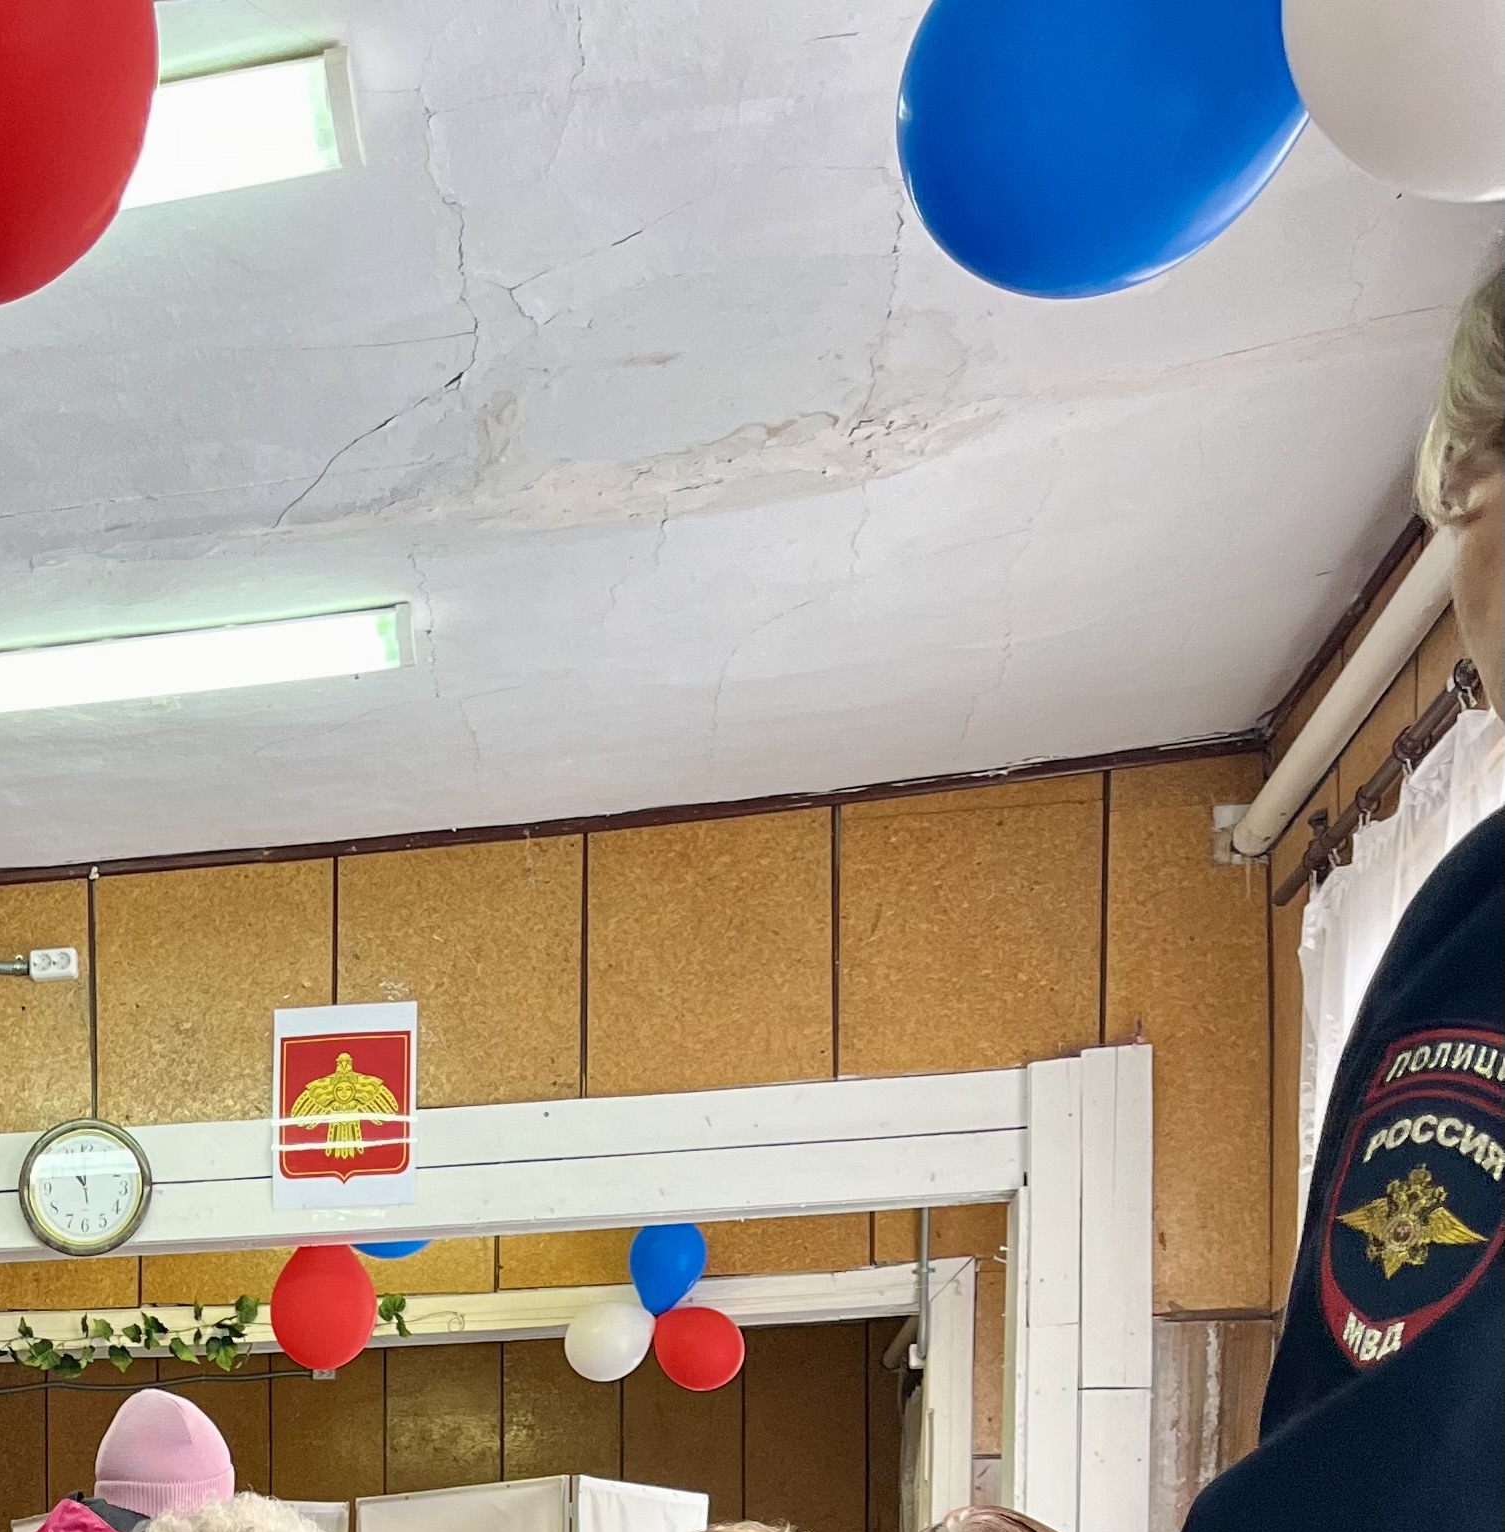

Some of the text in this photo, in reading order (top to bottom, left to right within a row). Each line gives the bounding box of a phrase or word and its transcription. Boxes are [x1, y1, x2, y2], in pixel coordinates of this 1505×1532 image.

[1363, 1114, 1505, 1182] РОССИЯ
[43, 1182, 53, 1197] 9
[118, 1180, 129, 1197] 3
[49, 1200, 60, 1216] 8
[111, 1199, 122, 1215] 4
[65, 1213, 75, 1230] 7
[81, 1217, 90, 1233] 6
[98, 1213, 108, 1229] 5
[1343, 1311, 1405, 1362] МВД
